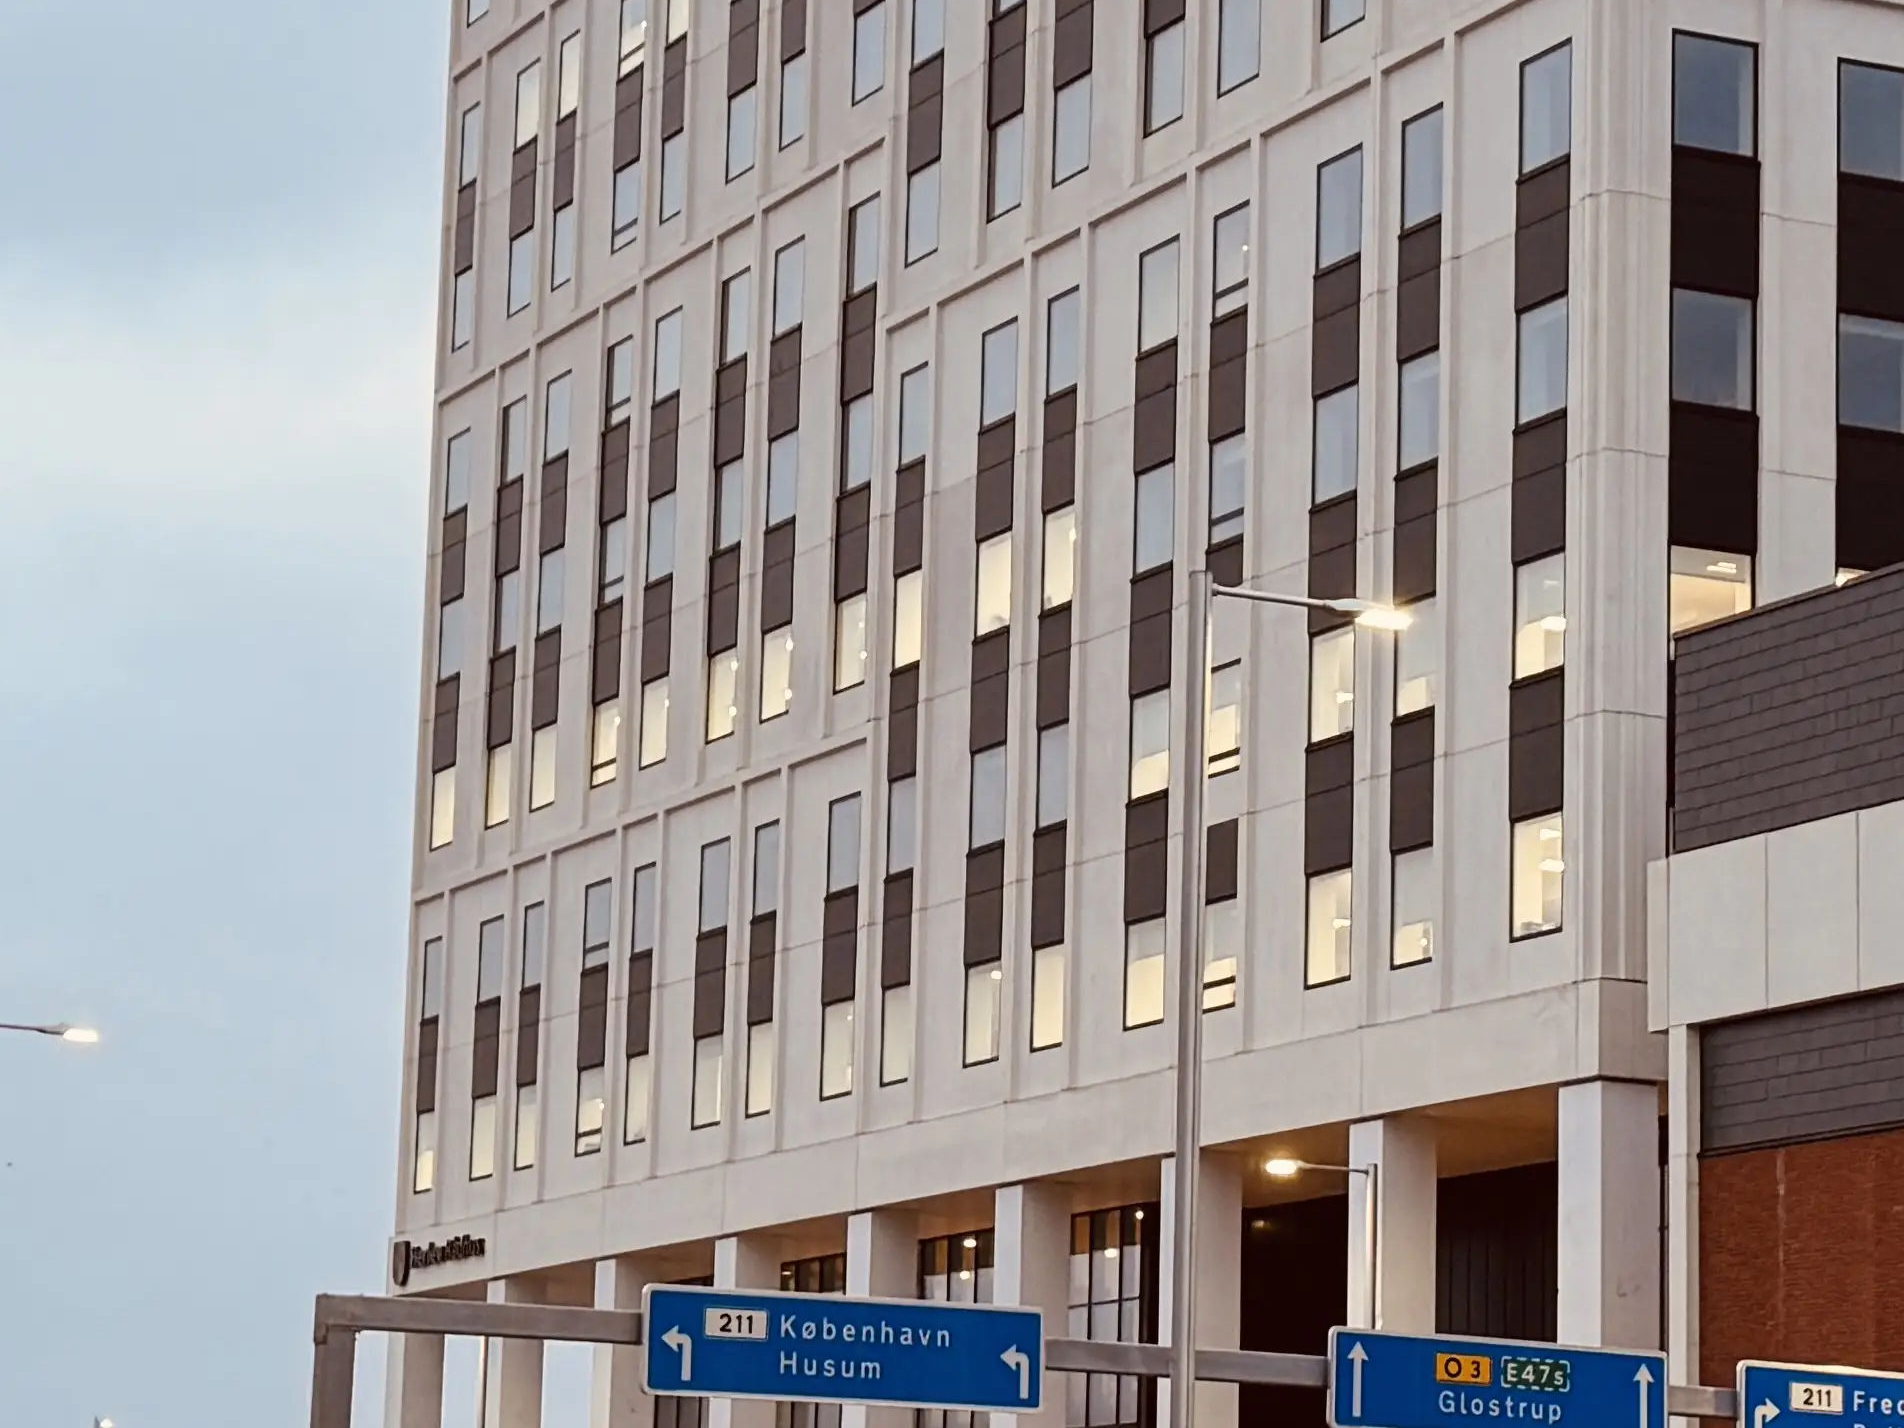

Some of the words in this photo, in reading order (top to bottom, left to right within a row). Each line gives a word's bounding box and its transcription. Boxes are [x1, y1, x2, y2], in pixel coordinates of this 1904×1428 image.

[718, 1312, 755, 1334] 211
[780, 1315, 951, 1348] København
[779, 1352, 882, 1379] Husum
[1438, 1390, 1563, 1425] Glostrup
[1802, 1387, 1833, 1408] 211
